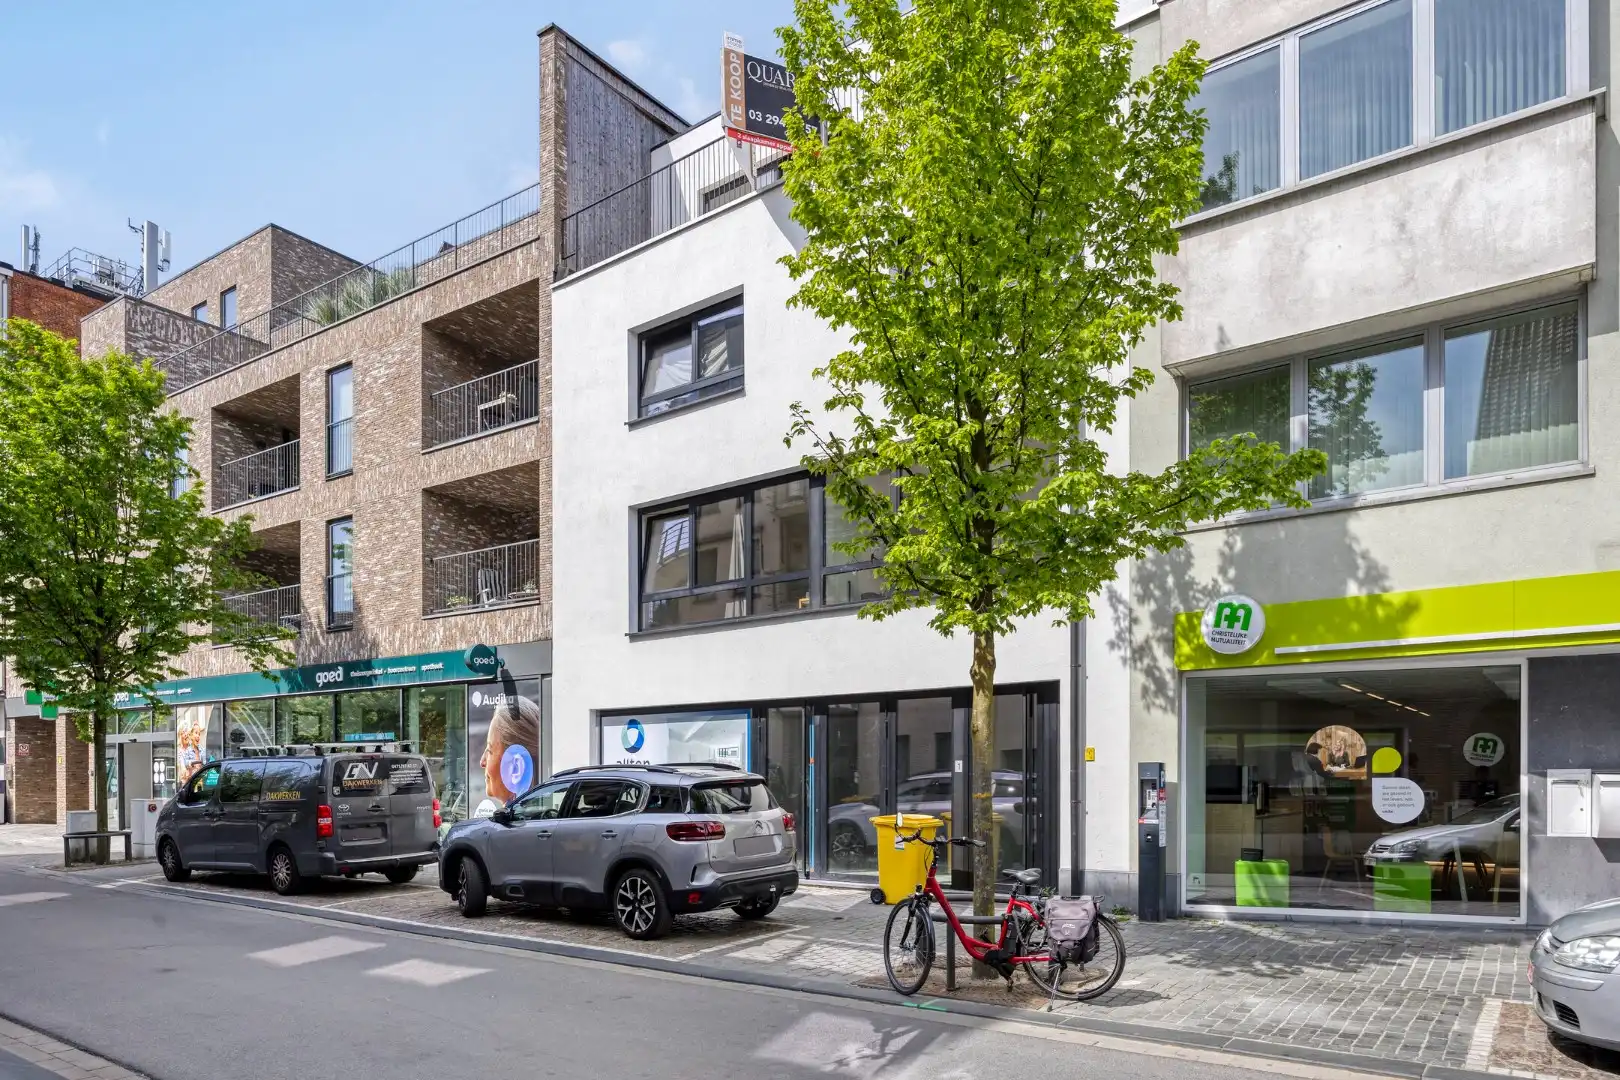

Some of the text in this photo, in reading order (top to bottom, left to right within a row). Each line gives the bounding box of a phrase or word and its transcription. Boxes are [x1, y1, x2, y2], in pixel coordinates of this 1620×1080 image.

[746, 61, 795, 88] QUAR
[730, 52, 742, 122] TE KOOP
[748, 109, 763, 121] 03
[1211, 630, 1248, 639] CHRISTELIJKE
[1210, 637, 1247, 646] MUTUALITEIT
[474, 655, 495, 667] goed
[315, 665, 344, 688] goed
[482, 692, 514, 706] Audika
[342, 778, 383, 788] DAKWERKEN
[266, 789, 301, 801] DAKWERKEN
